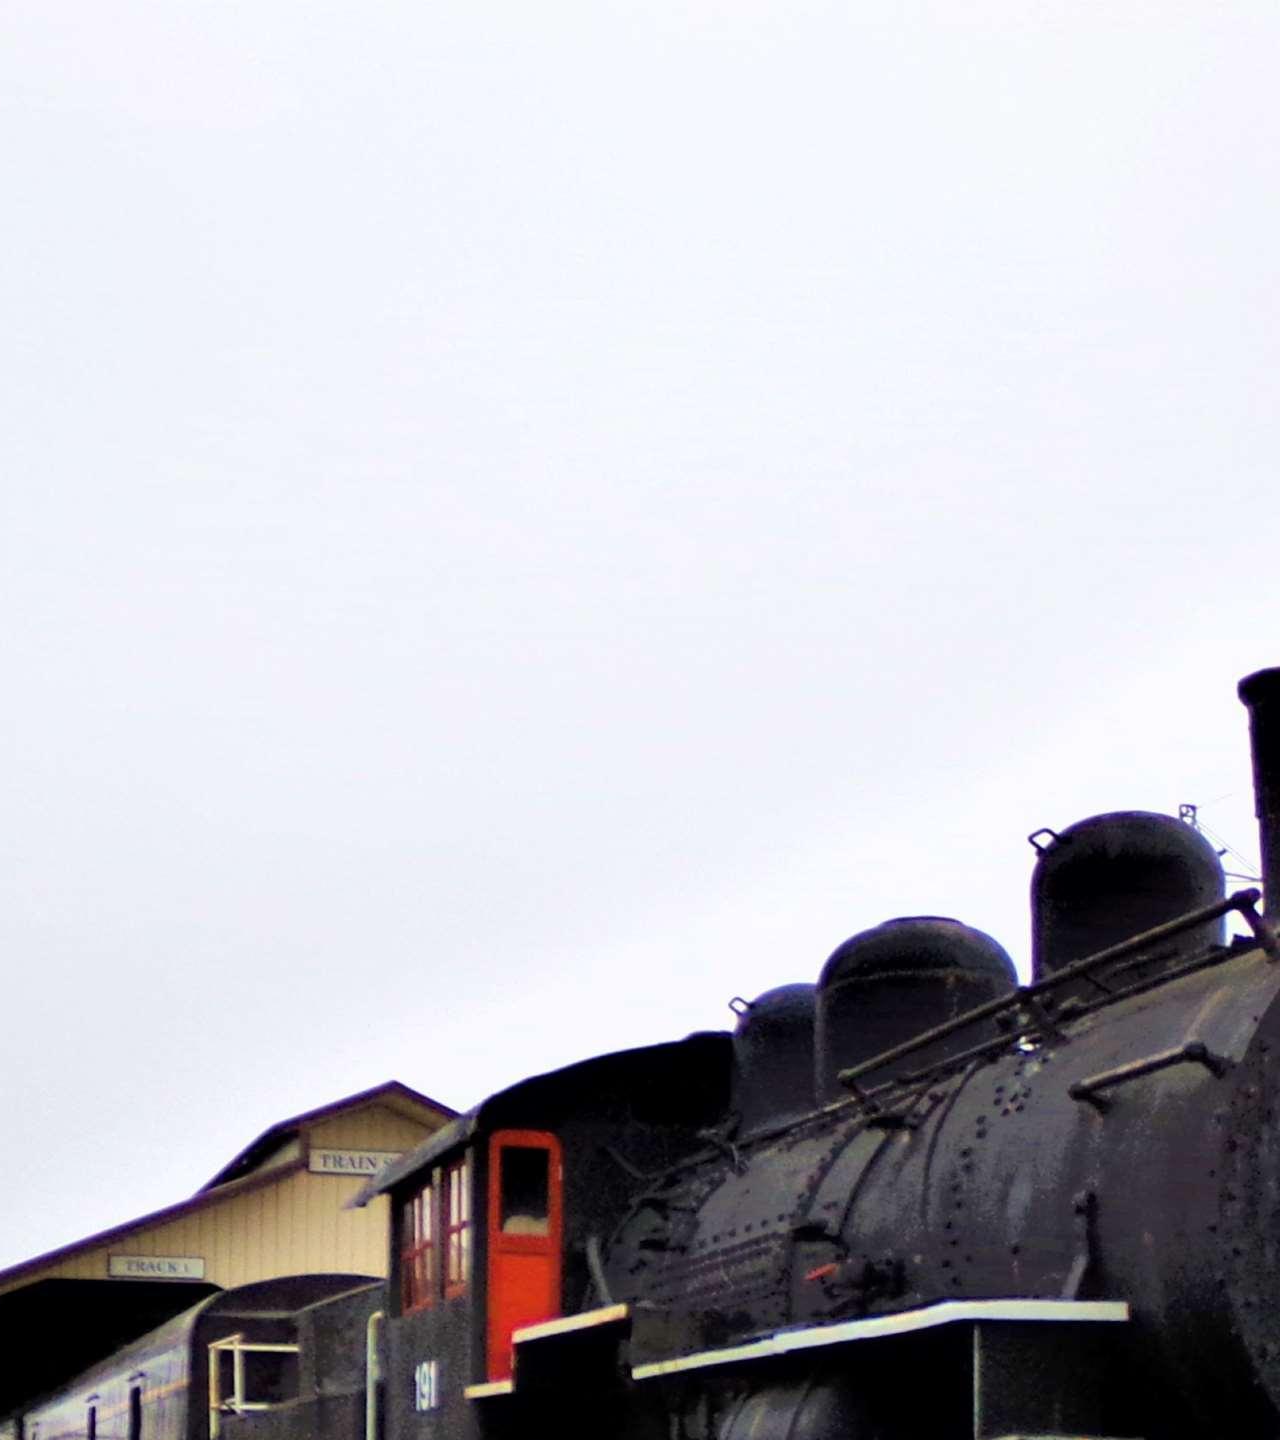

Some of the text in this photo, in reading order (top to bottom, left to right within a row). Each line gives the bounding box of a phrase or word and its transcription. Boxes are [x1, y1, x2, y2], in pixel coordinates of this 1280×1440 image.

[320, 1153, 378, 1169] TRAIN
[125, 1261, 177, 1274] TRACK
[415, 1360, 437, 1411] 191
